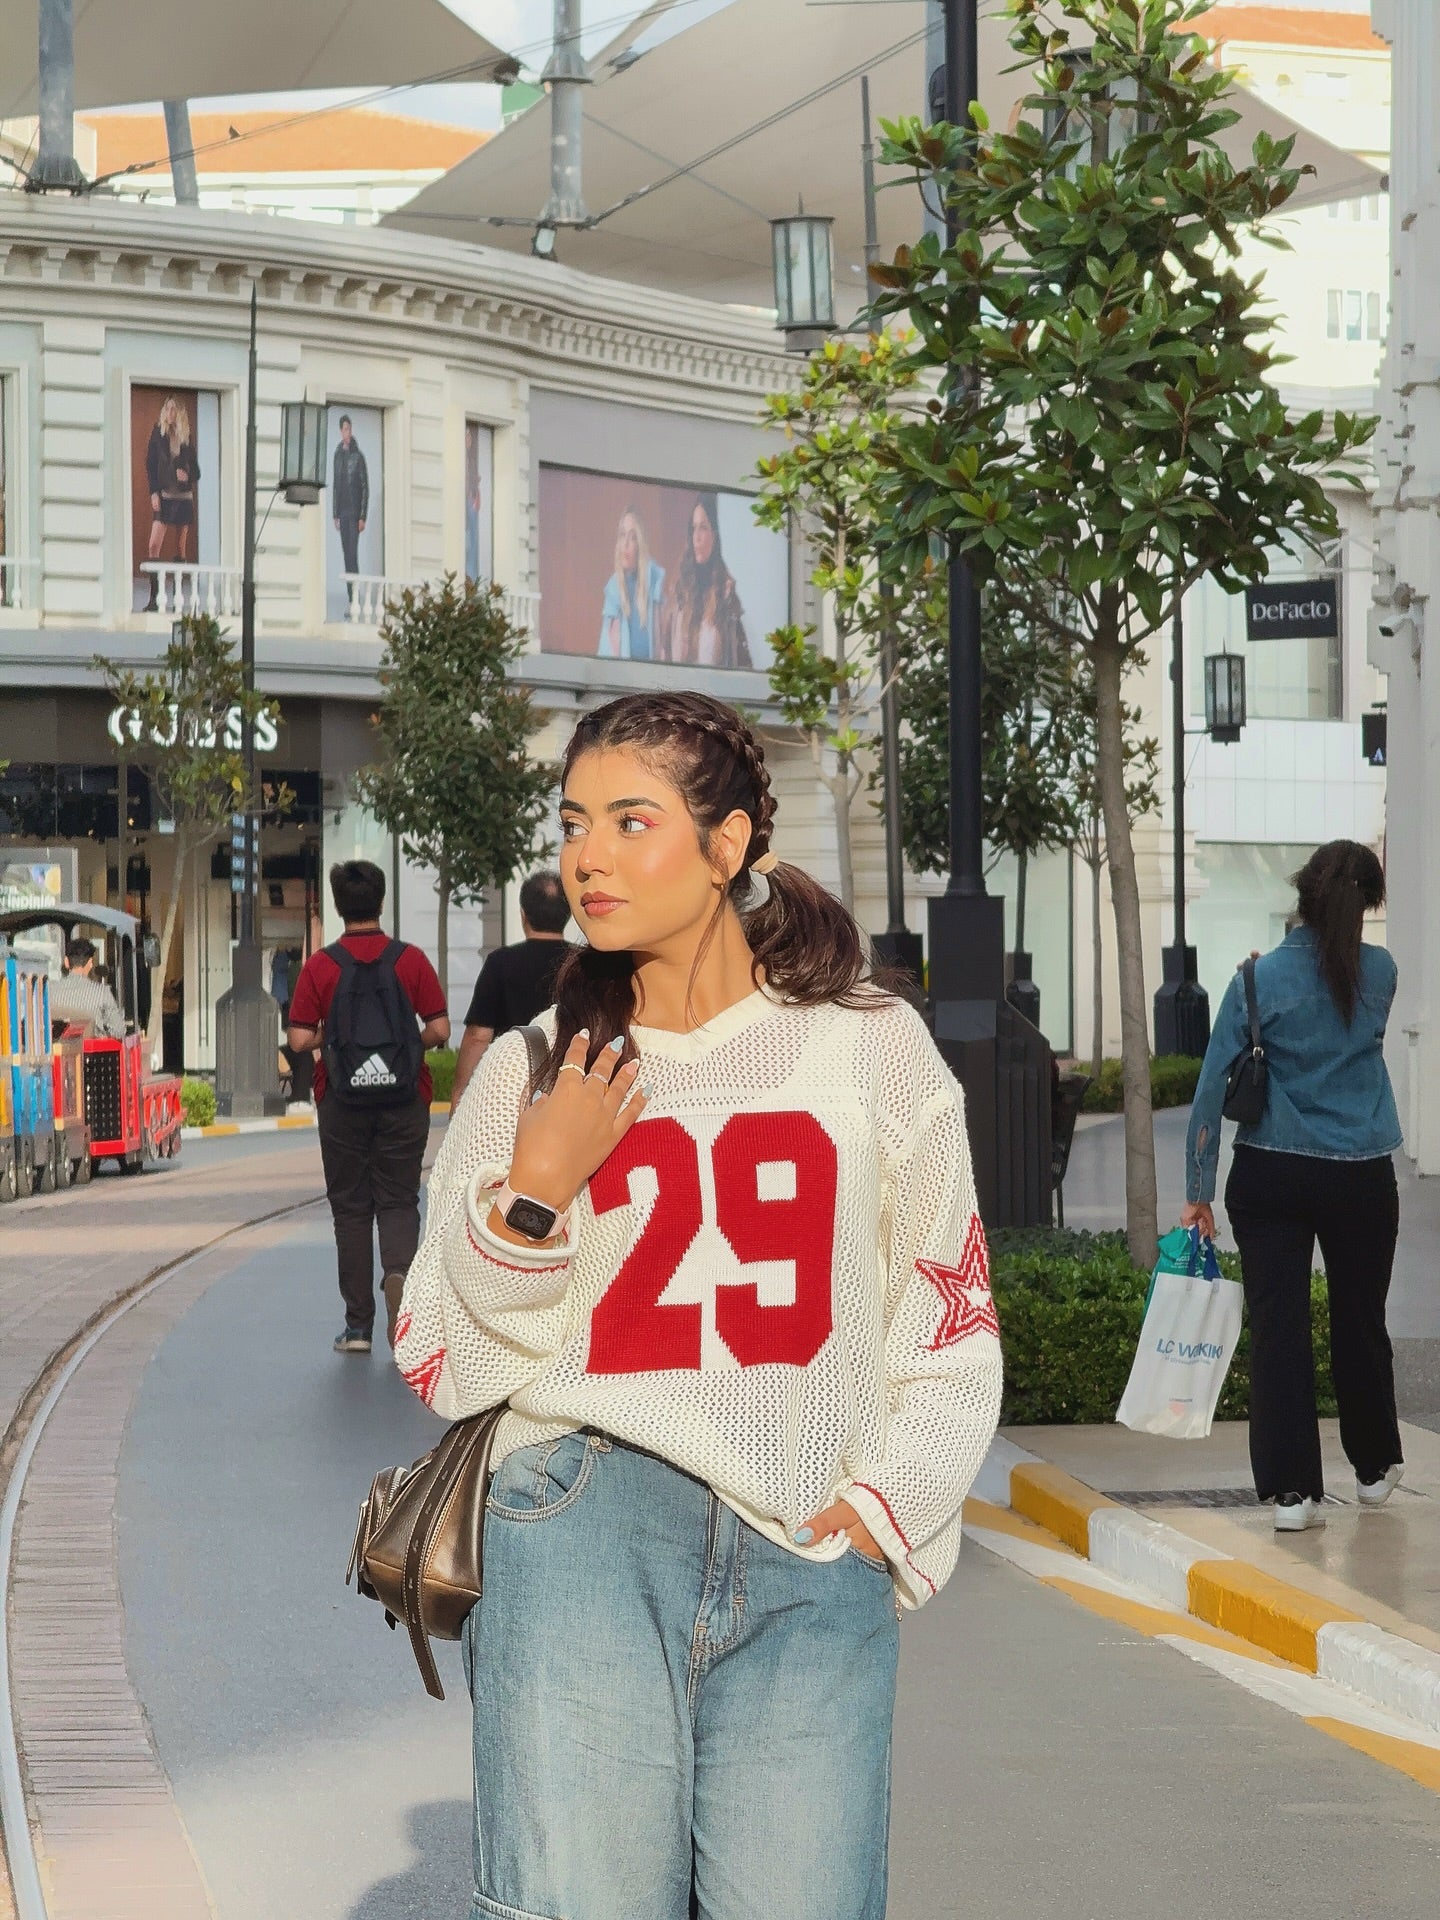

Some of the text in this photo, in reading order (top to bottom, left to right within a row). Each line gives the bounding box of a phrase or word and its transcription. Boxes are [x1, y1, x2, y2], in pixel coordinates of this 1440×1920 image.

[1252, 600, 1331, 621] DeFacto
[350, 1073, 397, 1087] adidas
[585, 1111, 838, 1374] 29
[1156, 1338, 1175, 1354] LC
